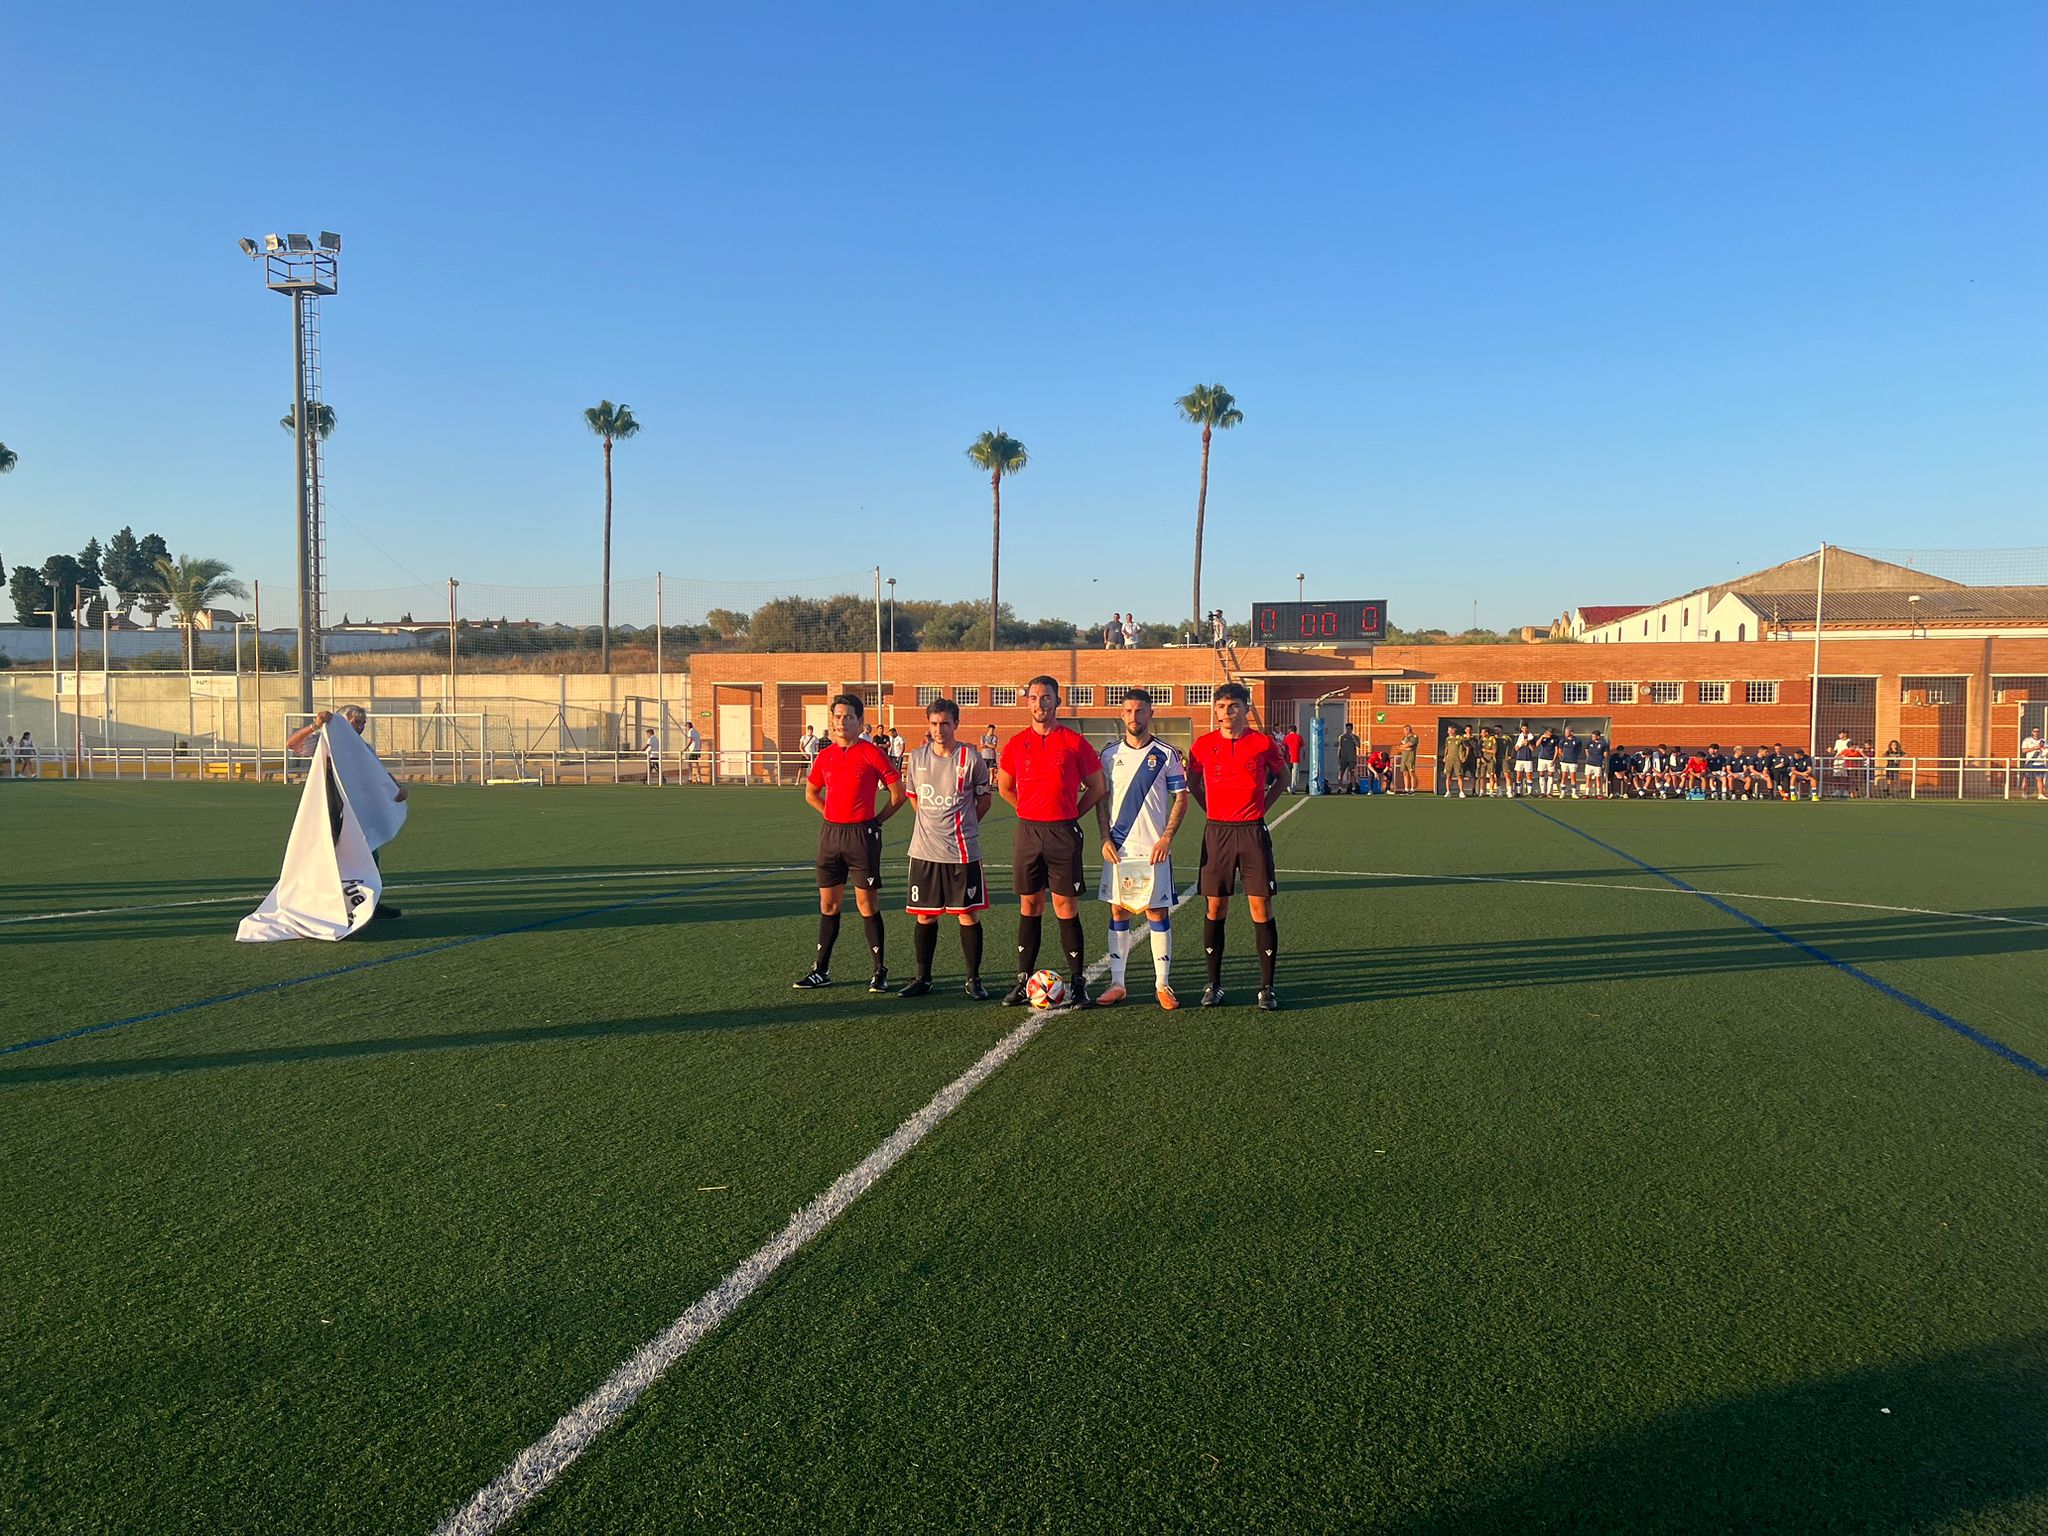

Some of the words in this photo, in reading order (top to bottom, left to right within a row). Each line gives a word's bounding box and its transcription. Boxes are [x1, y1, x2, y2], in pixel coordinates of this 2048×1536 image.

[1260, 608, 1277, 632] 0
[1301, 612, 1337, 637] 00
[1361, 606, 1378, 632] 0
[911, 885, 919, 902] 8
